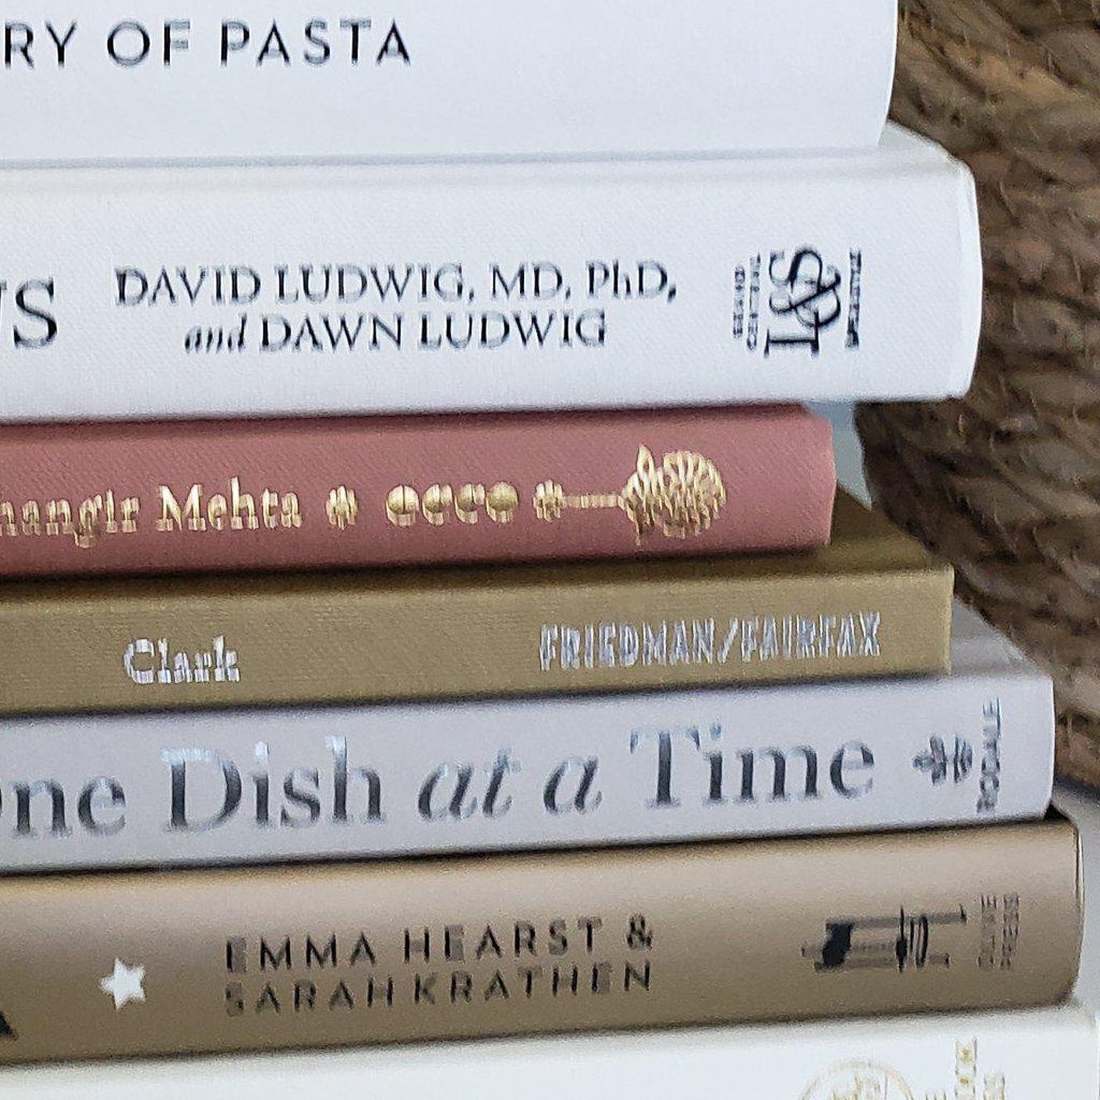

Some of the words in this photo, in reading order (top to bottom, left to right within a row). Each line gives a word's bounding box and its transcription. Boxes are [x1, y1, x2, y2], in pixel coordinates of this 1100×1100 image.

[106, 19, 194, 69] OF
[218, 17, 413, 68] PASTA
[114, 264, 262, 307] DAVID
[274, 261, 475, 305] LUDWIG,
[184, 312, 248, 355] and
[259, 312, 403, 353] DAWN
[417, 308, 607, 350] LUDWIG
[156, 475, 301, 533] Mehta
[123, 635, 240, 684] Clark
[160, 733, 386, 834] Dish
[418, 749, 520, 825] at
[543, 756, 603, 814] a
[630, 724, 876, 809] Time
[225, 931, 376, 973] EMMA
[403, 915, 602, 963] HEARST
[626, 913, 654, 952] &
[225, 976, 394, 1017] SARAH
[414, 960, 652, 1005] KRATHEN
